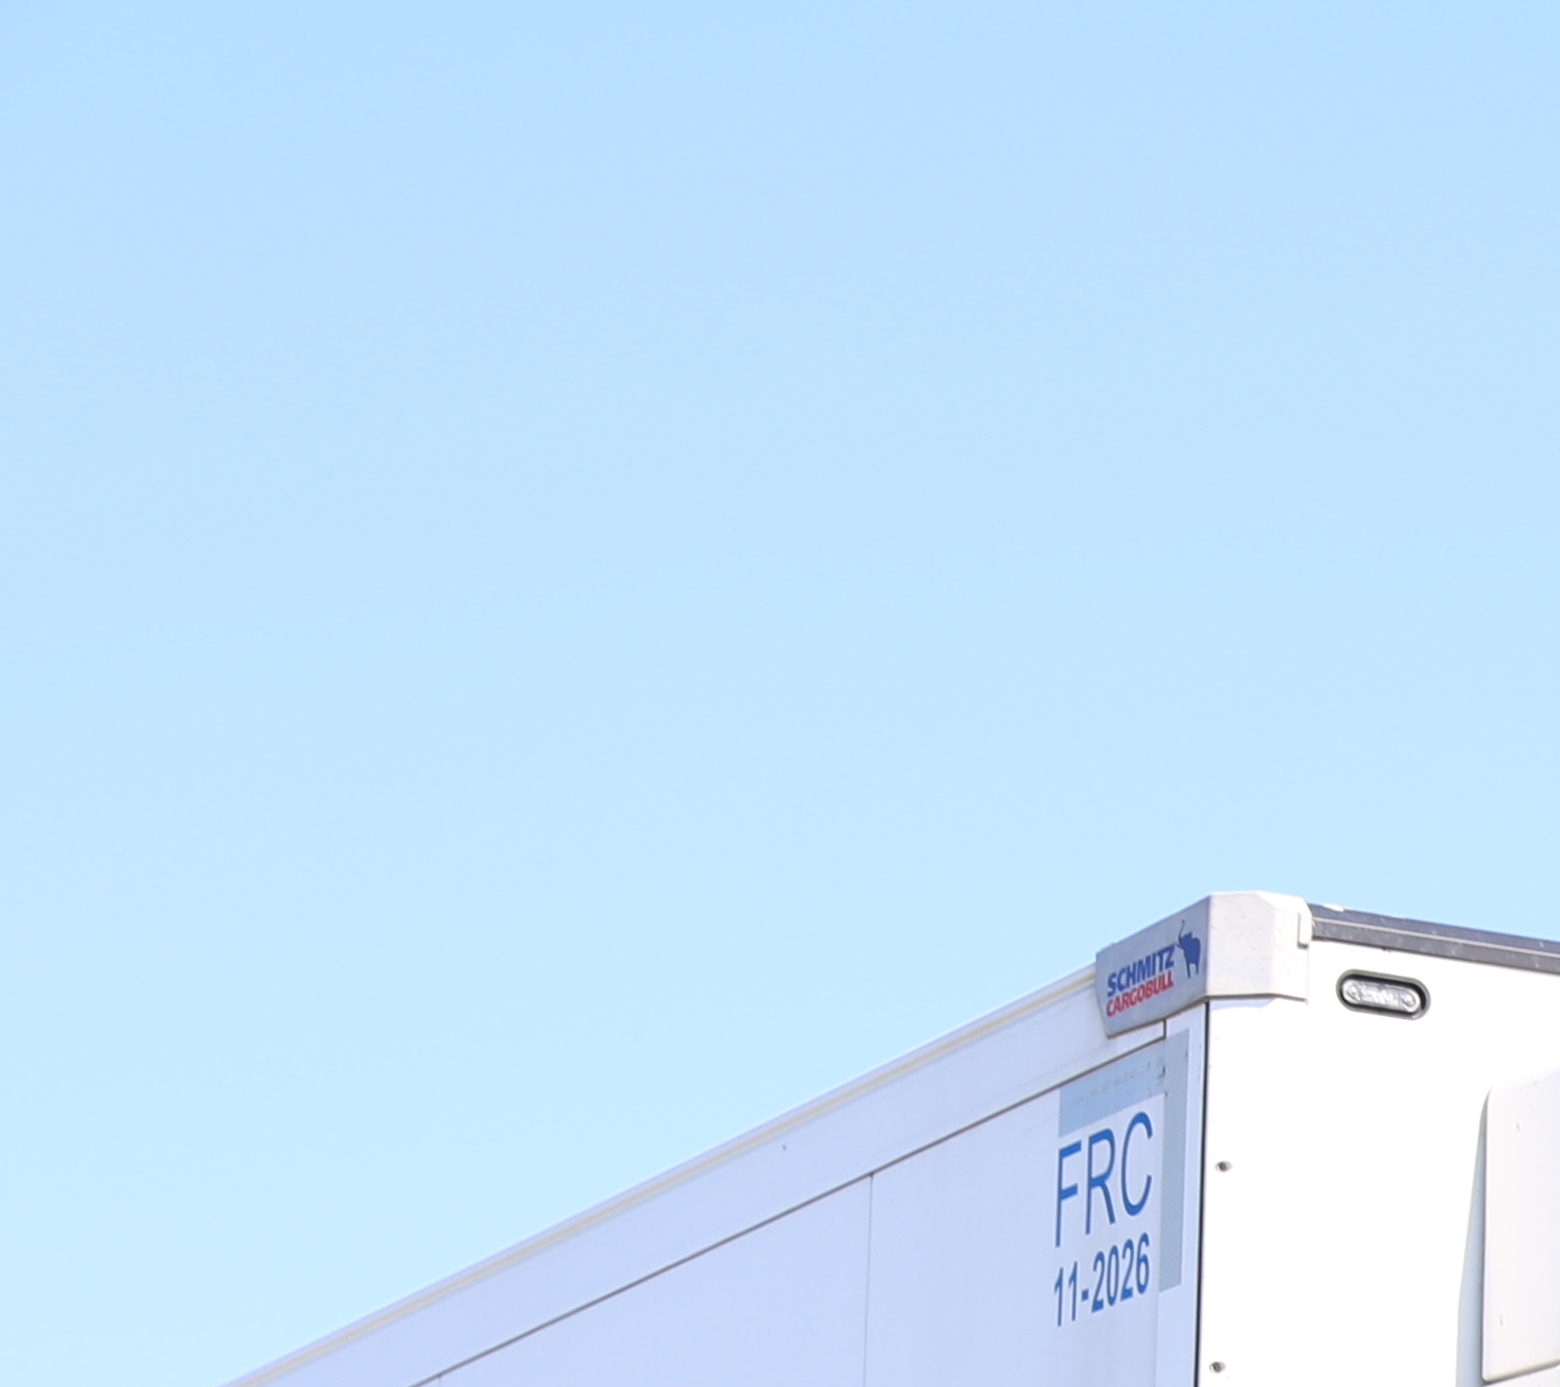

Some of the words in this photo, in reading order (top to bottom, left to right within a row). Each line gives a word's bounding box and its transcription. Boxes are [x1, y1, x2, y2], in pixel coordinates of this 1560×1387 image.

[1106, 970, 1175, 1017] CARGOBULL
[1107, 943, 1176, 997] SCHMITZ
[1055, 1111, 1154, 1248] FRC
[1053, 1231, 1151, 1328] 11-2026
